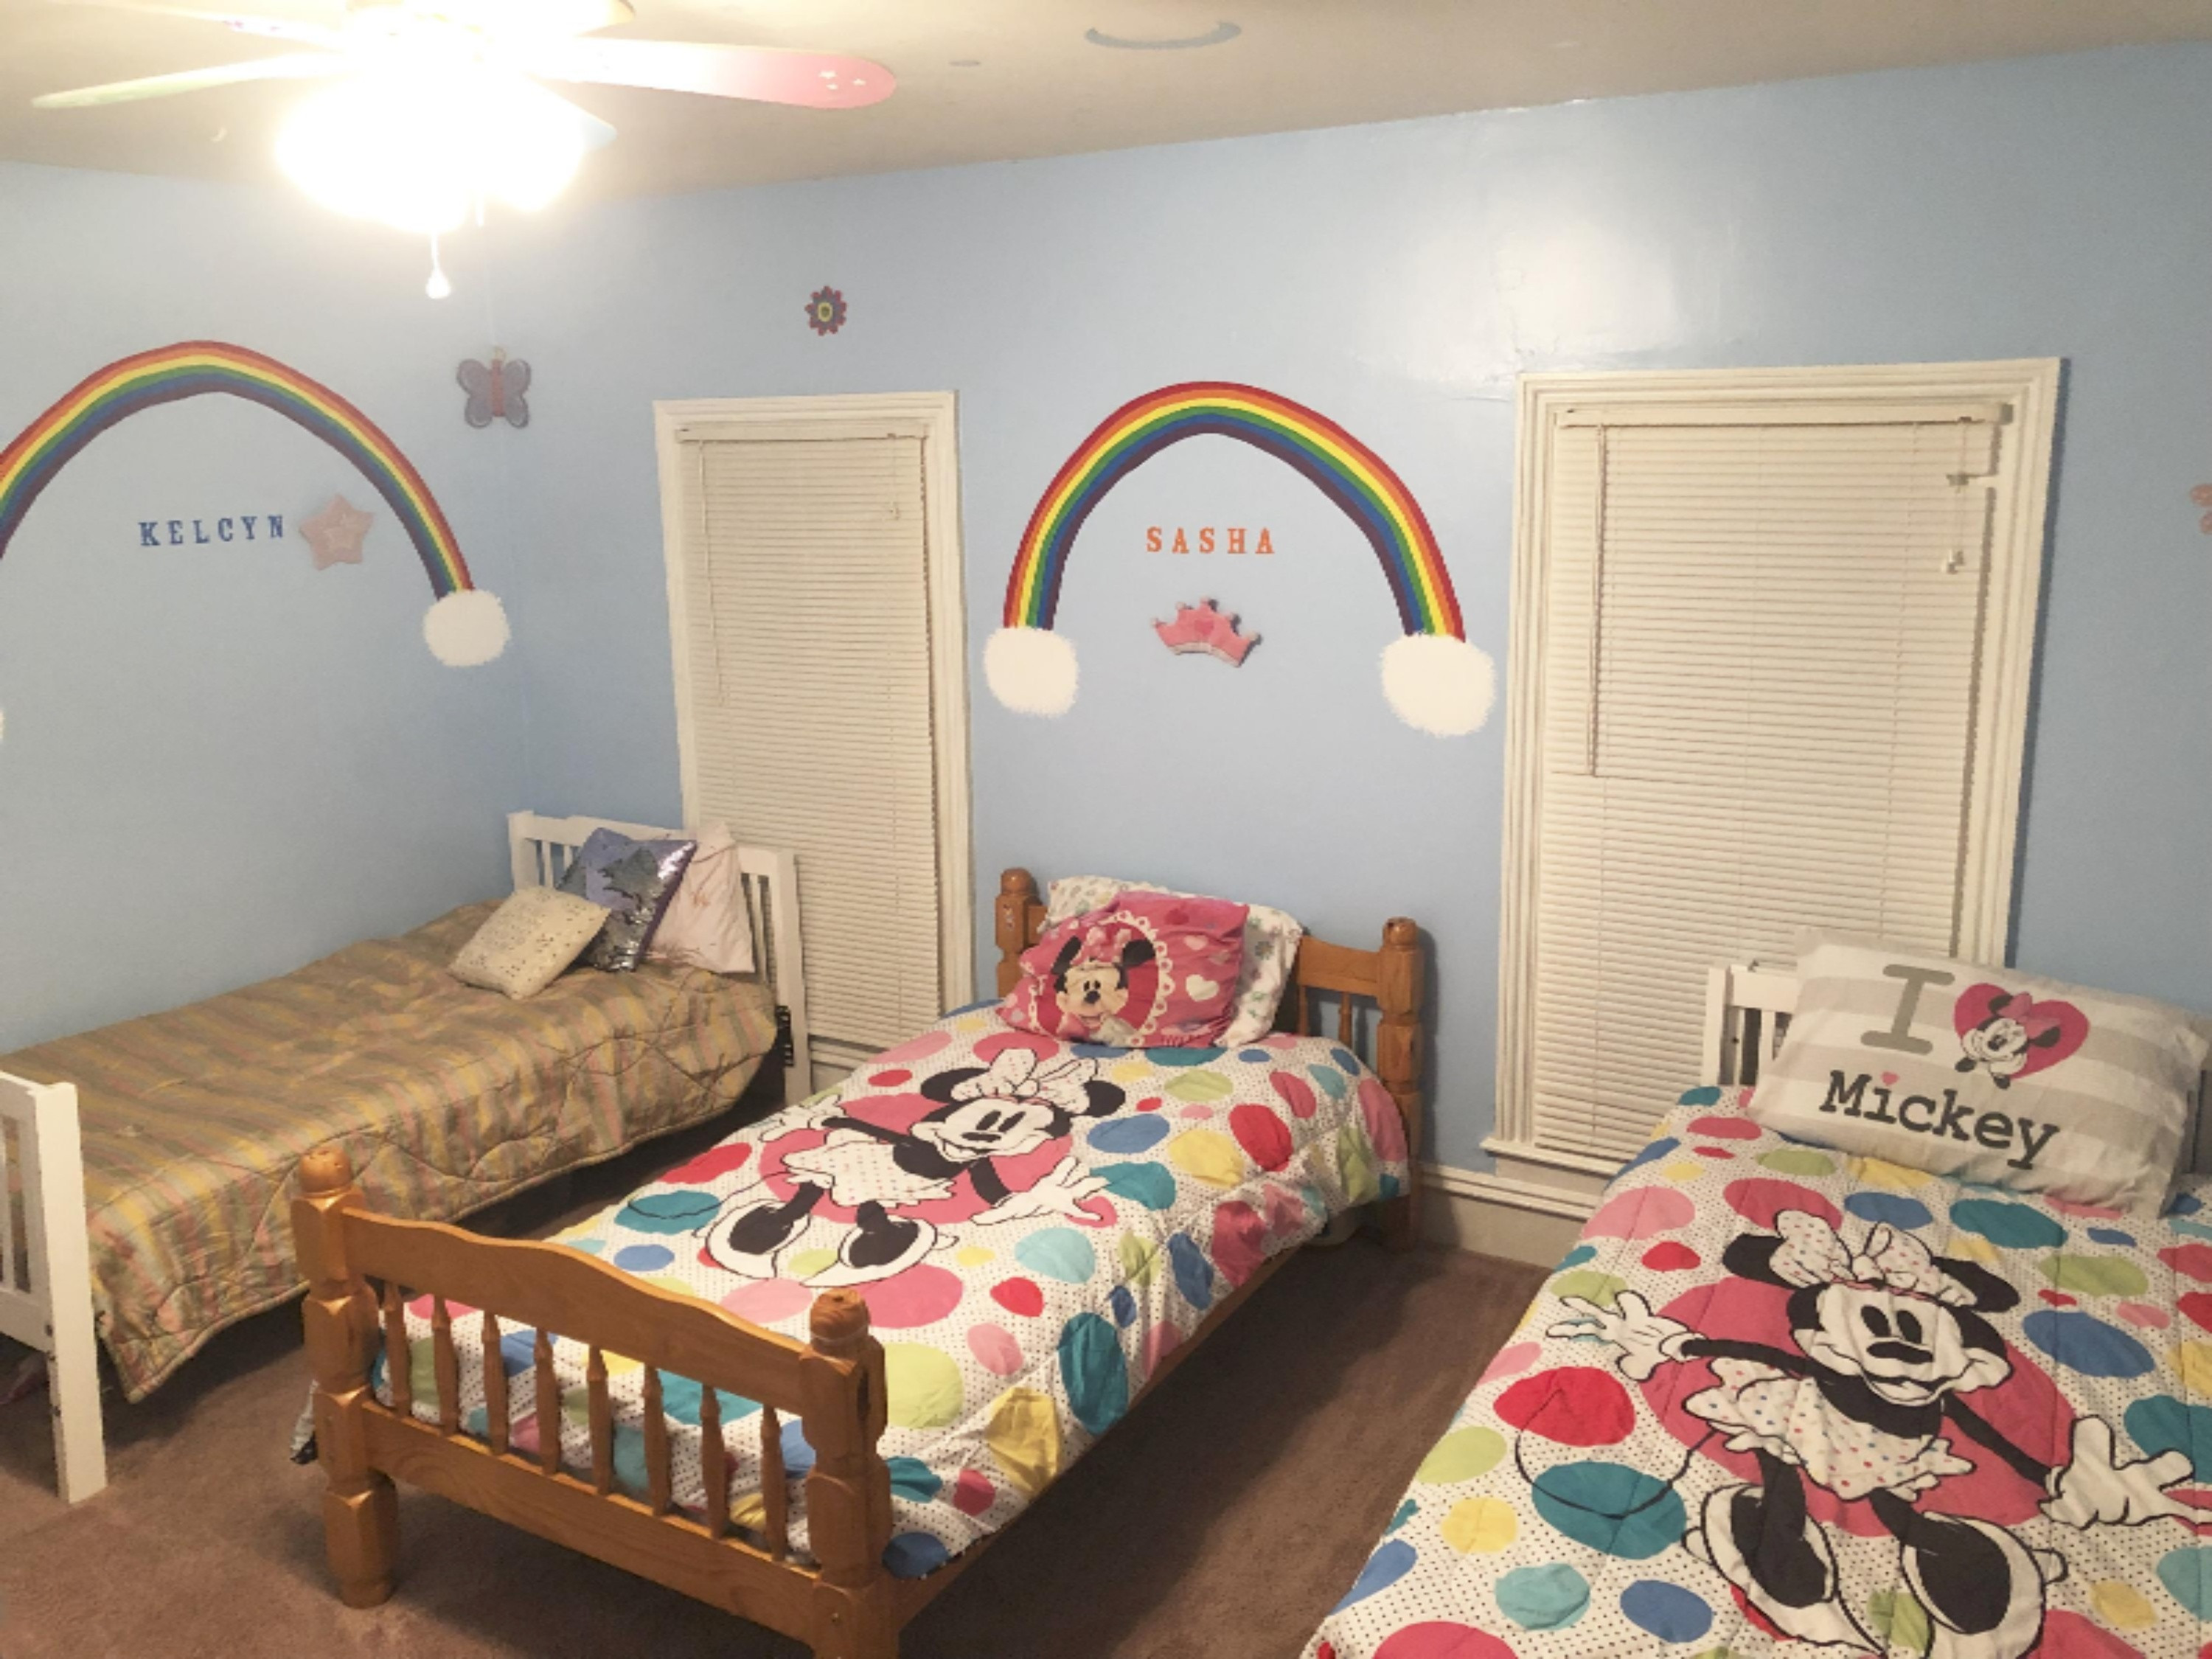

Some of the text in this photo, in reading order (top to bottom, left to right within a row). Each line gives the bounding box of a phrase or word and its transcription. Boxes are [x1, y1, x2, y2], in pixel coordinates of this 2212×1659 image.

[138, 515, 284, 546] KELCYN
[1146, 526, 1275, 554] SASHA
[1860, 963, 1955, 1055] I
[1818, 1069, 2061, 1171] Mickey
